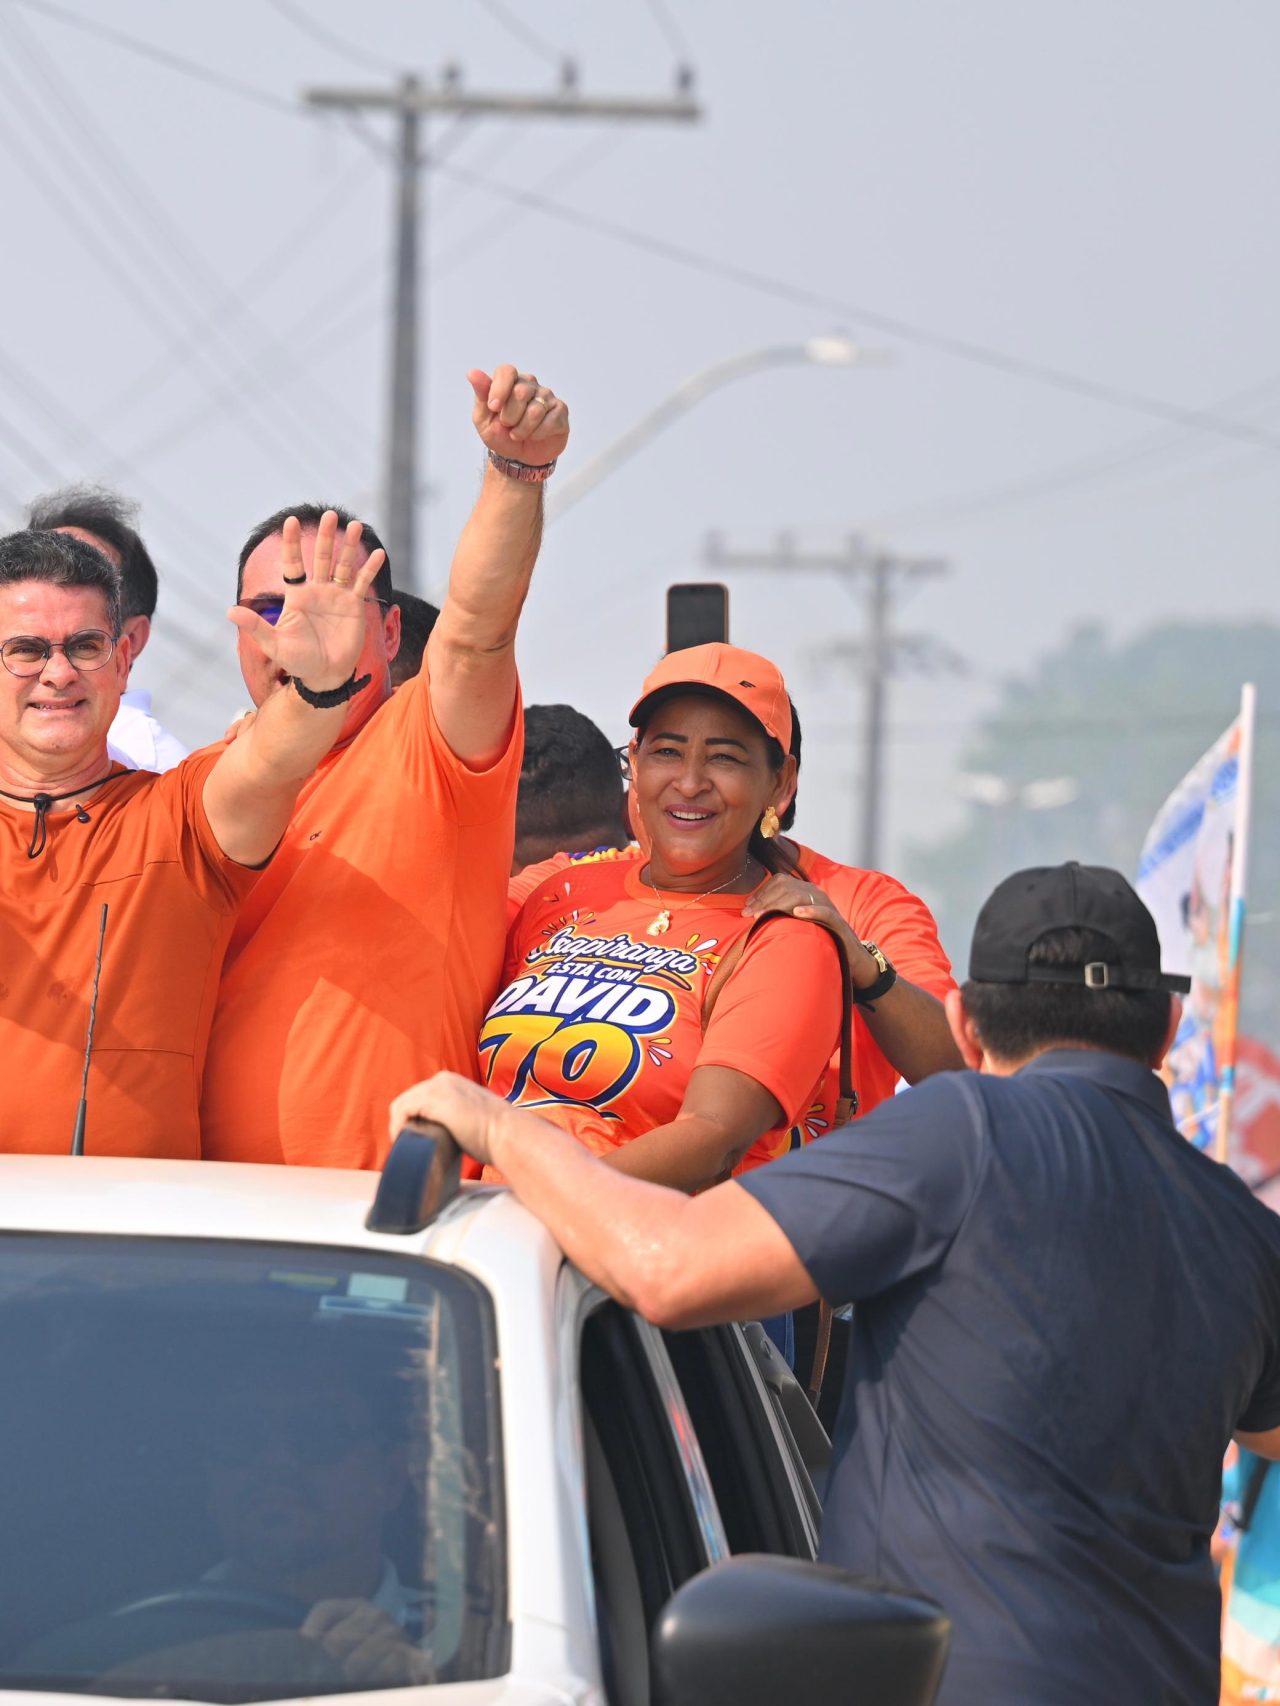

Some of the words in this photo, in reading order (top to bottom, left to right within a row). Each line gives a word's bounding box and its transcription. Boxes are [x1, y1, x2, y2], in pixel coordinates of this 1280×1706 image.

[548, 961, 595, 977] ESTÁ
[594, 967, 640, 982] COM
[485, 975, 670, 1027] DAVID
[479, 1014, 641, 1106] 70
